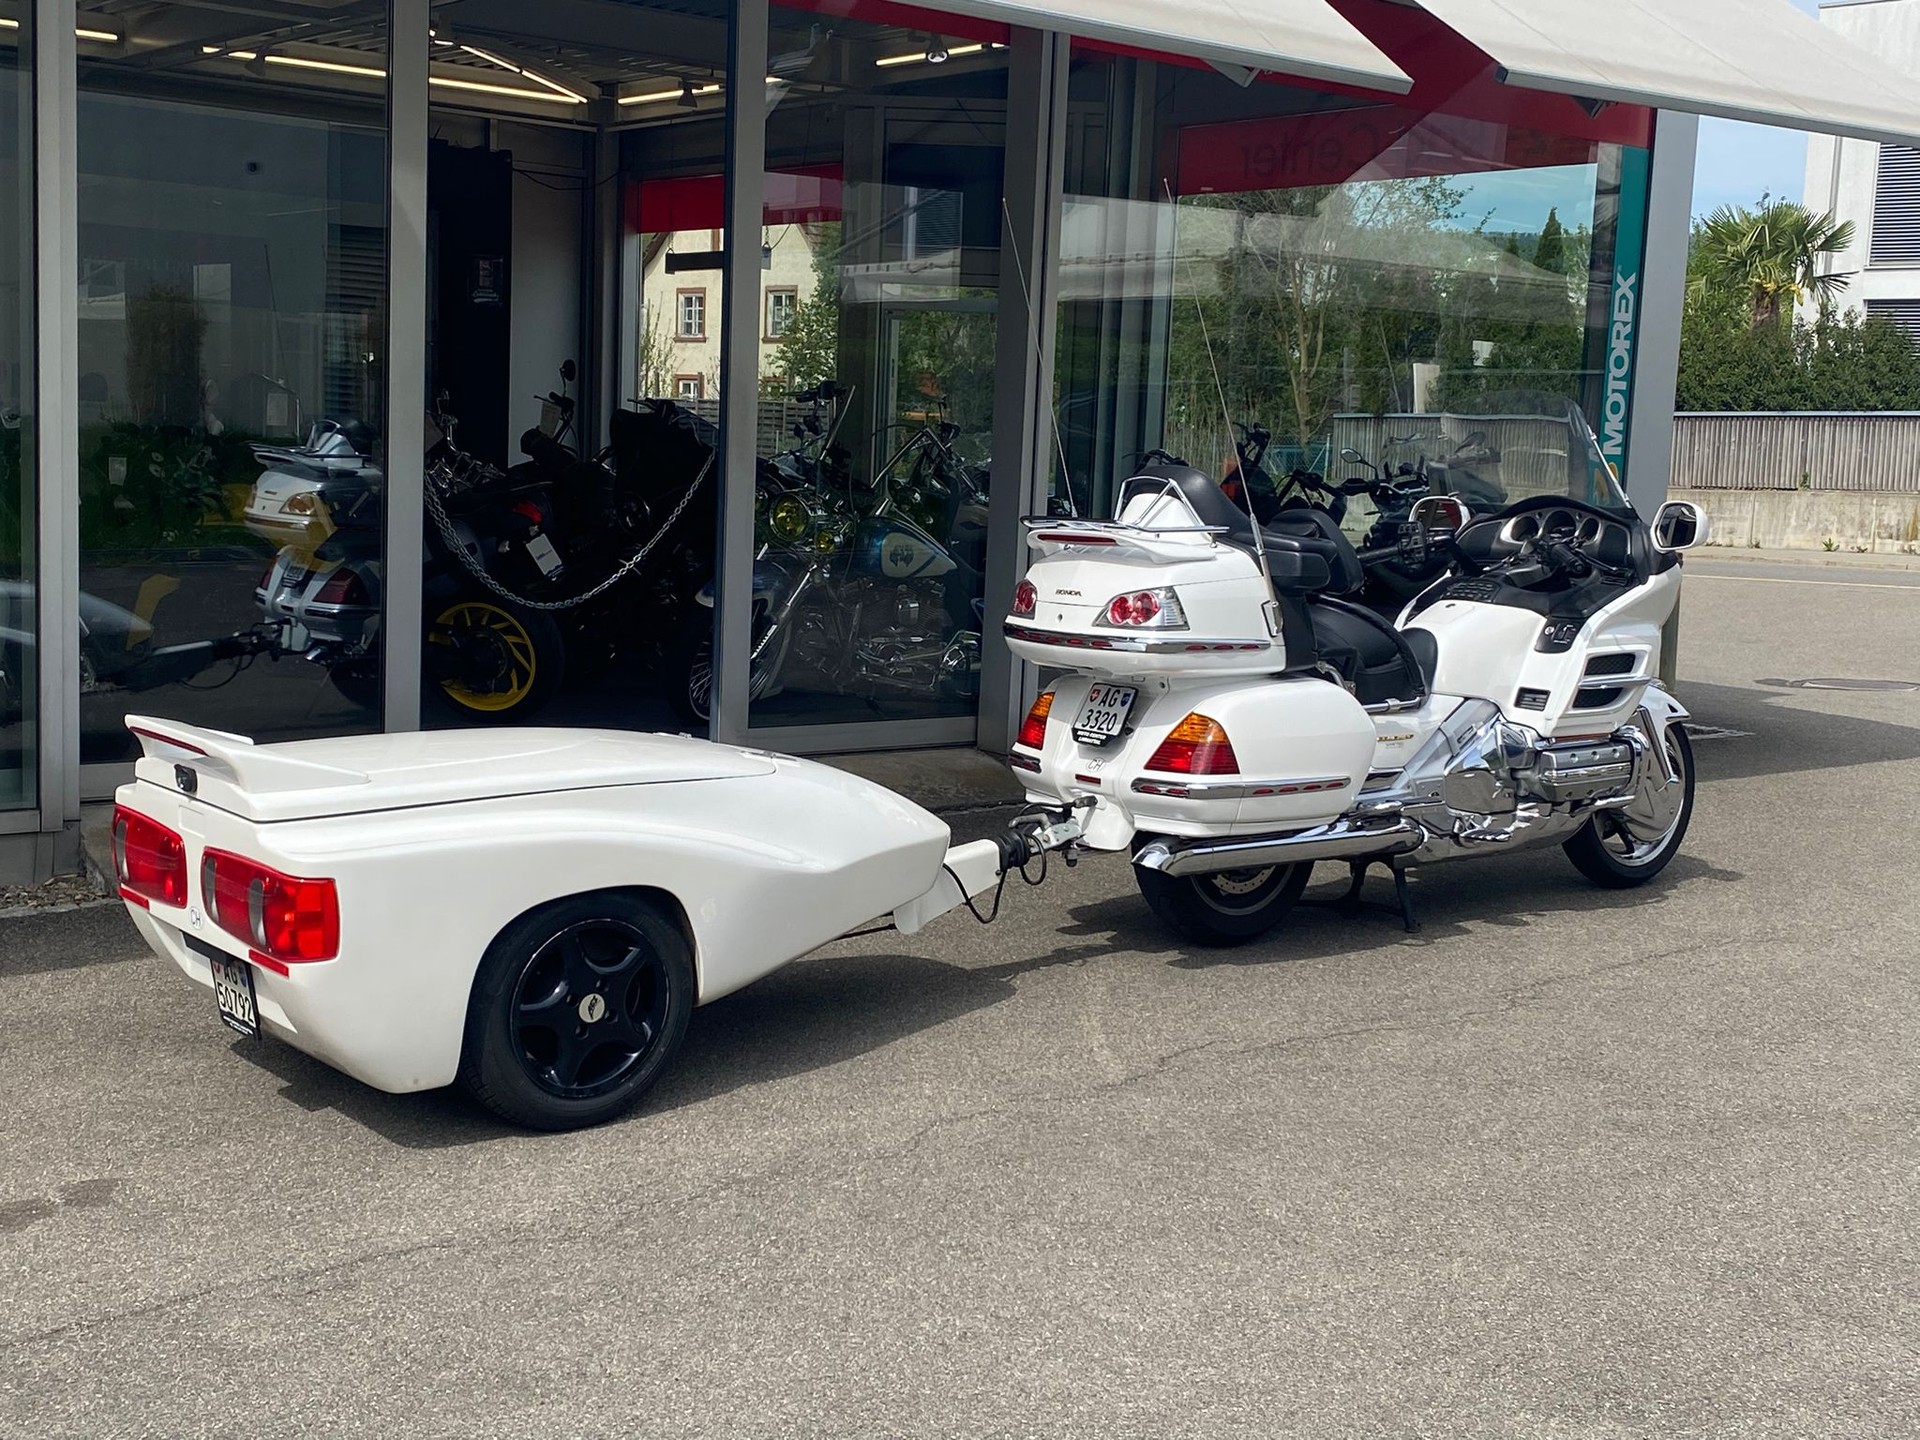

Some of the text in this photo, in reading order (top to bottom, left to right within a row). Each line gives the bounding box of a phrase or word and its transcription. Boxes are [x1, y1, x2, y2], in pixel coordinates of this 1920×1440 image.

[1603, 272, 1636, 456] MOTOREX
[1098, 687, 1121, 708] AG
[1081, 708, 1118, 732] 3320
[1087, 758, 1105, 771] CH
[190, 908, 201, 927] CH
[217, 981, 255, 1024] 50792
